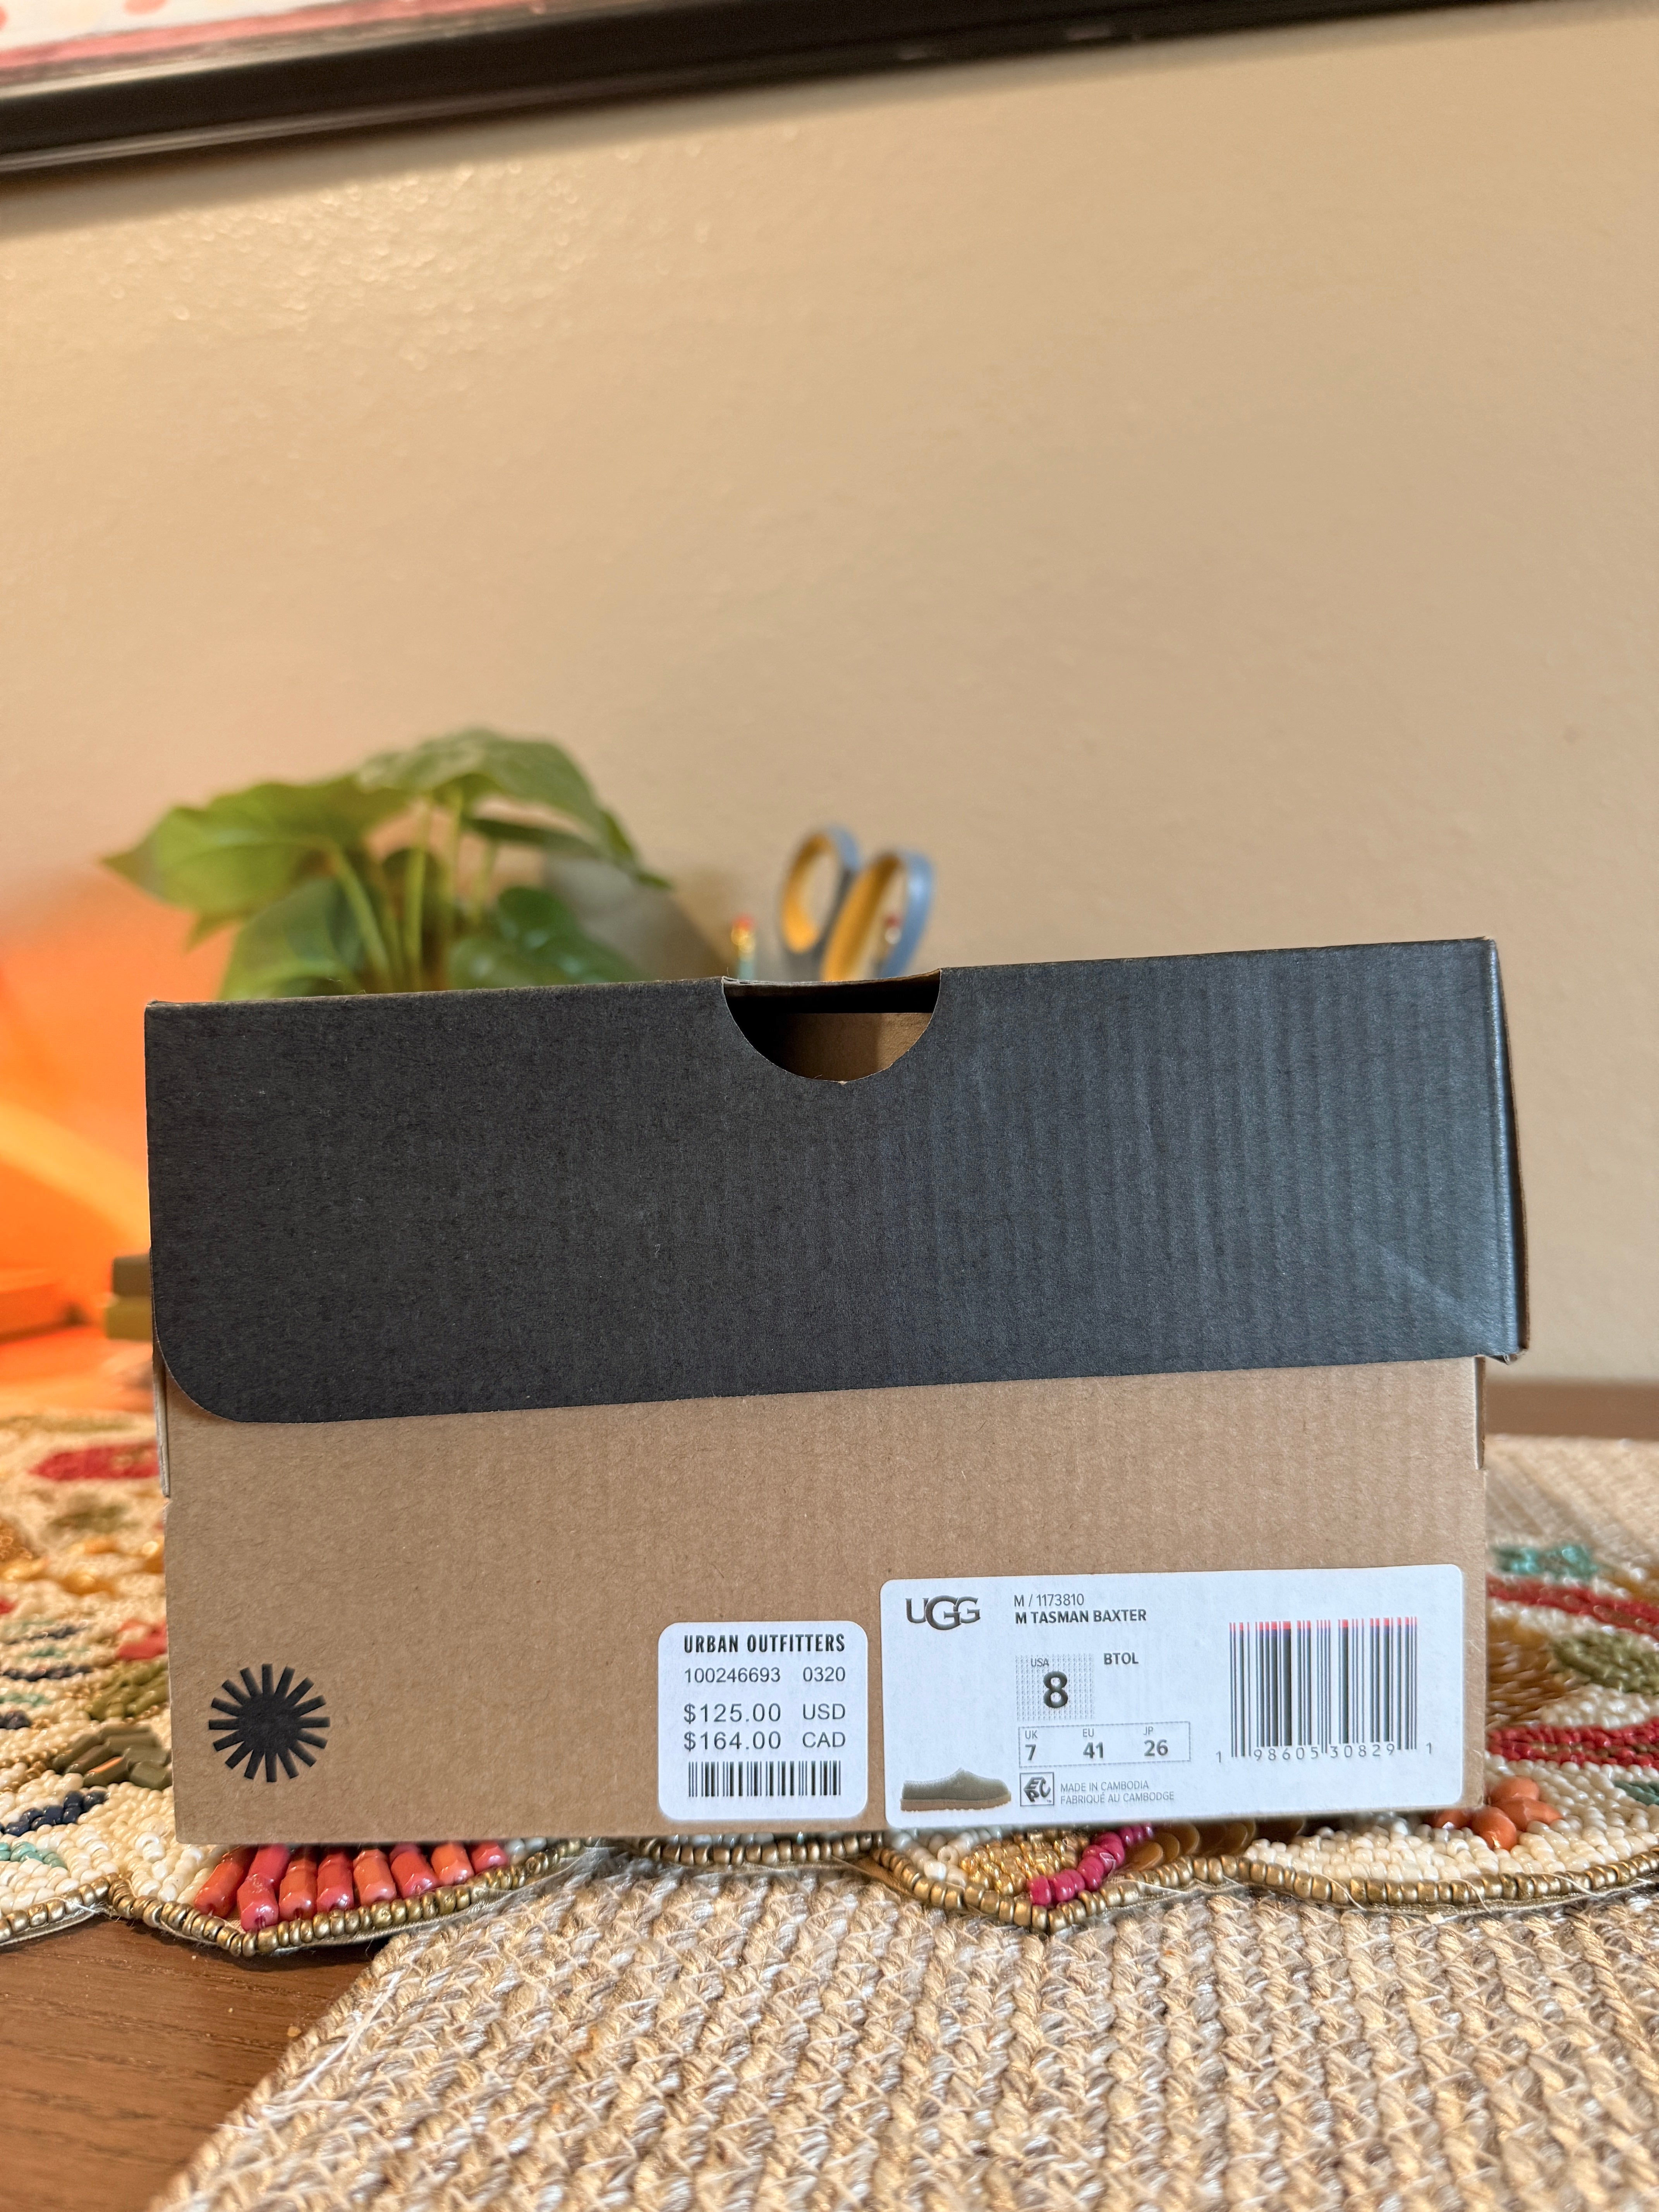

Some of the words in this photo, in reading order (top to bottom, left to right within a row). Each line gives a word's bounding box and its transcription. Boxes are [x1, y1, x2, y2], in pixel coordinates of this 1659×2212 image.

[1014, 1595, 1024, 1607] M
[1028, 1594, 1033, 1607] /
[1036, 1593, 1084, 1606] 1173810
[905, 1595, 981, 1631] UGG
[1015, 1612, 1027, 1624] M
[1030, 1610, 1089, 1624] TASMAN
[1093, 1609, 1146, 1622] BAXTER
[684, 1635, 738, 1653] URBAN
[747, 1633, 845, 1653] OUTFITTERS
[1030, 1658, 1049, 1667] USA
[1104, 1652, 1139, 1665] BTOL
[685, 1667, 781, 1683] 100246693
[803, 1666, 845, 1682] 0320
[1043, 1671, 1068, 1708] 8
[684, 1703, 781, 1724] $125.00
[803, 1703, 845, 1720] USD
[1025, 1729, 1038, 1740] UK
[1082, 1728, 1094, 1738] EU
[1143, 1726, 1154, 1736] JP
[684, 1731, 781, 1752] $164.00
[802, 1731, 846, 1748] CAD
[1144, 1739, 1168, 1757] 26
[1025, 1744, 1036, 1761] 7
[1083, 1742, 1103, 1759] 41
[1329, 1743, 1395, 1759] 30829
[1060, 1783, 1085, 1793] MADE
[1089, 1782, 1098, 1792] IN
[1101, 1780, 1149, 1791] CAMBODIA
[1061, 1791, 1105, 1805] FABRIQUÉ
[1108, 1793, 1120, 1803] AU
[1123, 1791, 1174, 1803] CAMBODGE
